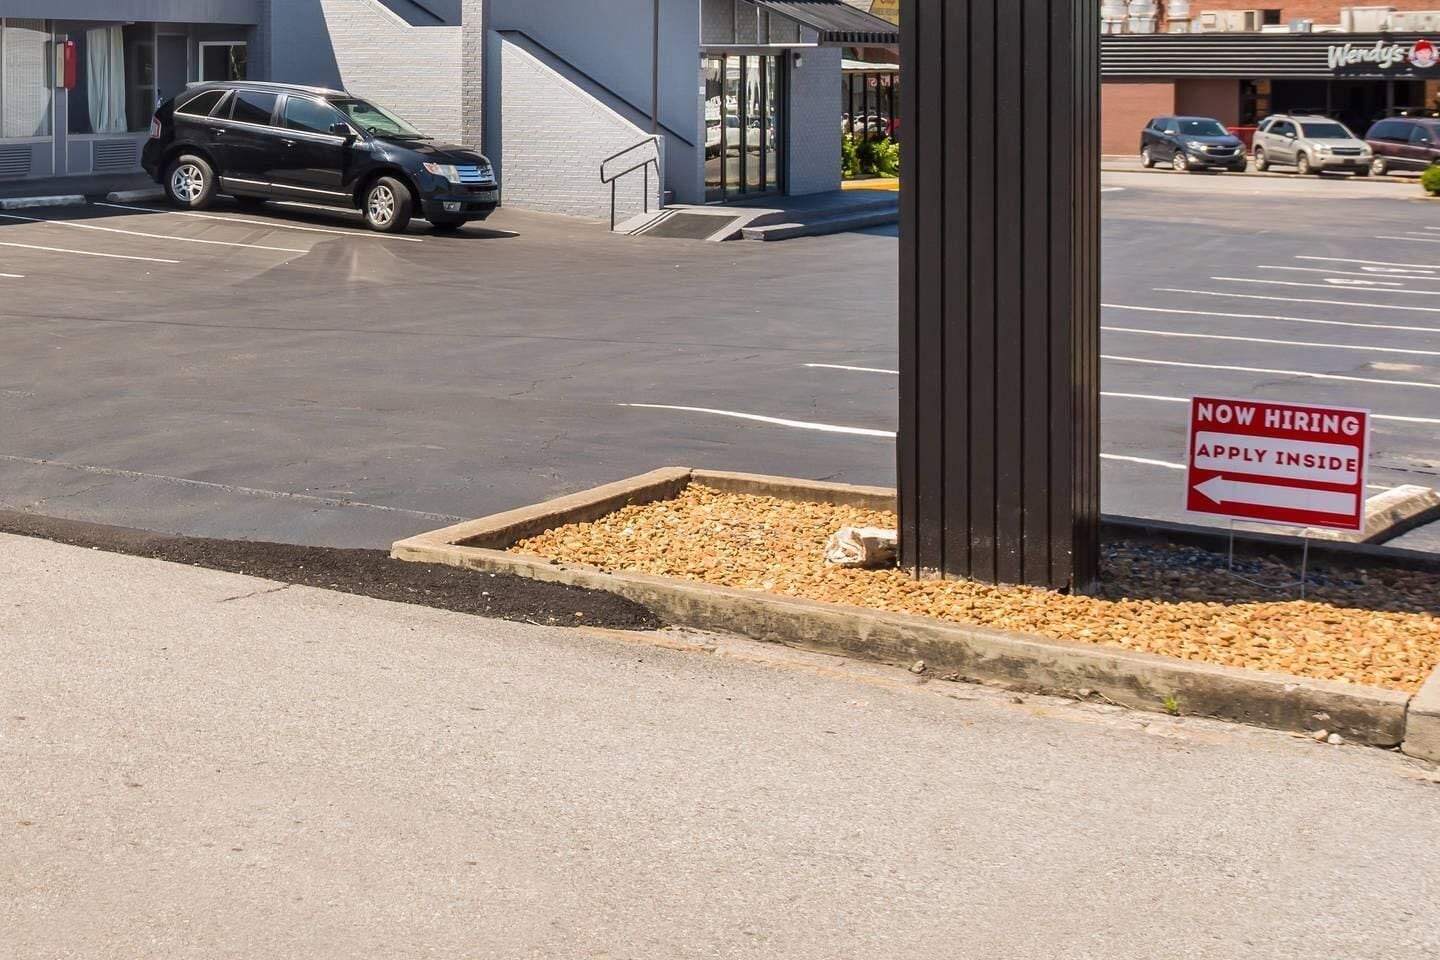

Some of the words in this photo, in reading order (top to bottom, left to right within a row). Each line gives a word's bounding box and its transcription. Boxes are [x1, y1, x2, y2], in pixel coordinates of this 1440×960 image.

[1328, 40, 1404, 69] Wendy's
[1197, 402, 1256, 425] NOW
[1264, 408, 1360, 436] HIRING
[1196, 443, 1267, 463] APPLY
[1275, 451, 1357, 472] INSIDE
